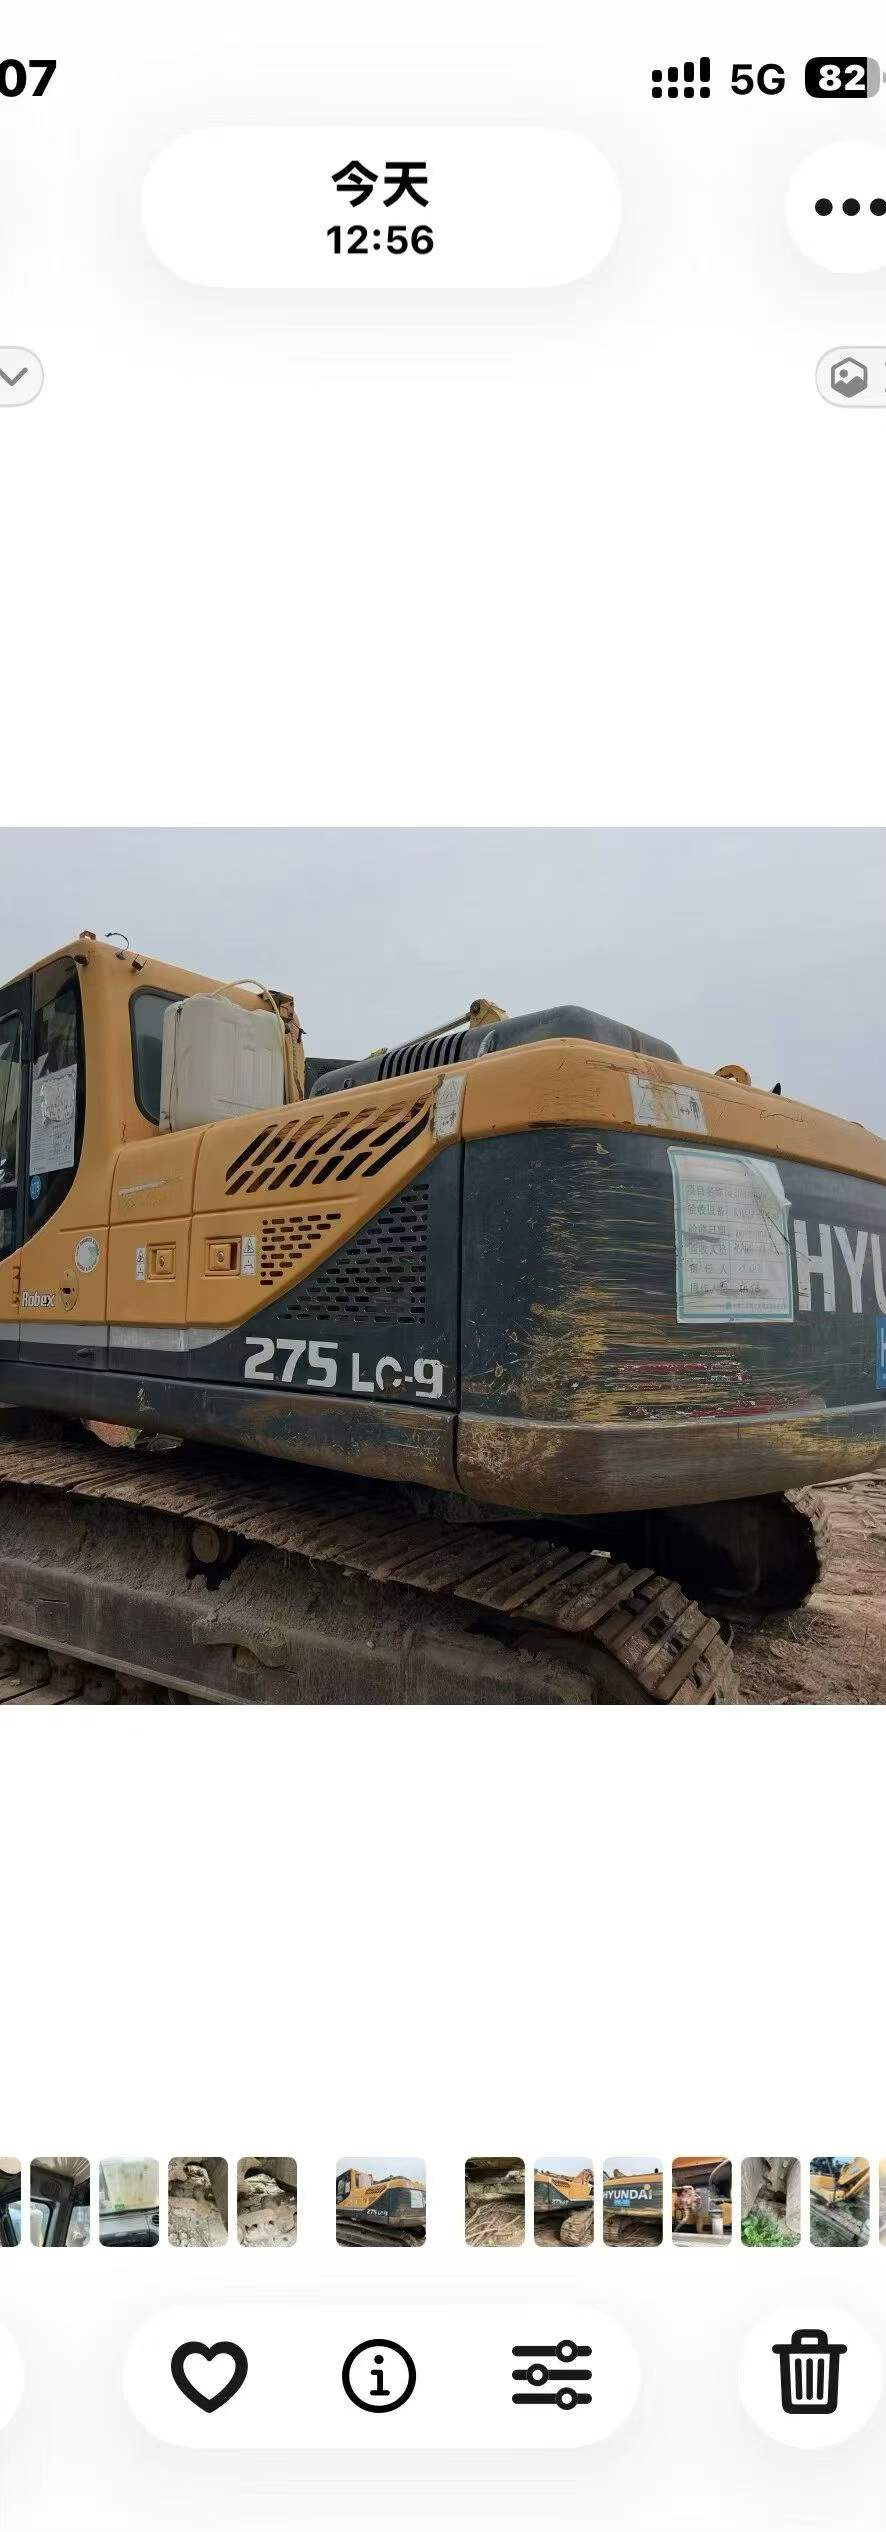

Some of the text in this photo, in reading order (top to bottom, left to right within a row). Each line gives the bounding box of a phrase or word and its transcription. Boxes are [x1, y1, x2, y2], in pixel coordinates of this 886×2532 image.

[0, 59, 57, 97] 07
[732, 64, 866, 95] 5G 82
[331, 160, 429, 208] 今天
[326, 225, 434, 255] 12:56
[22, 1291, 55, 1308] Robex
[244, 1336, 445, 1400] 275 LC-9
